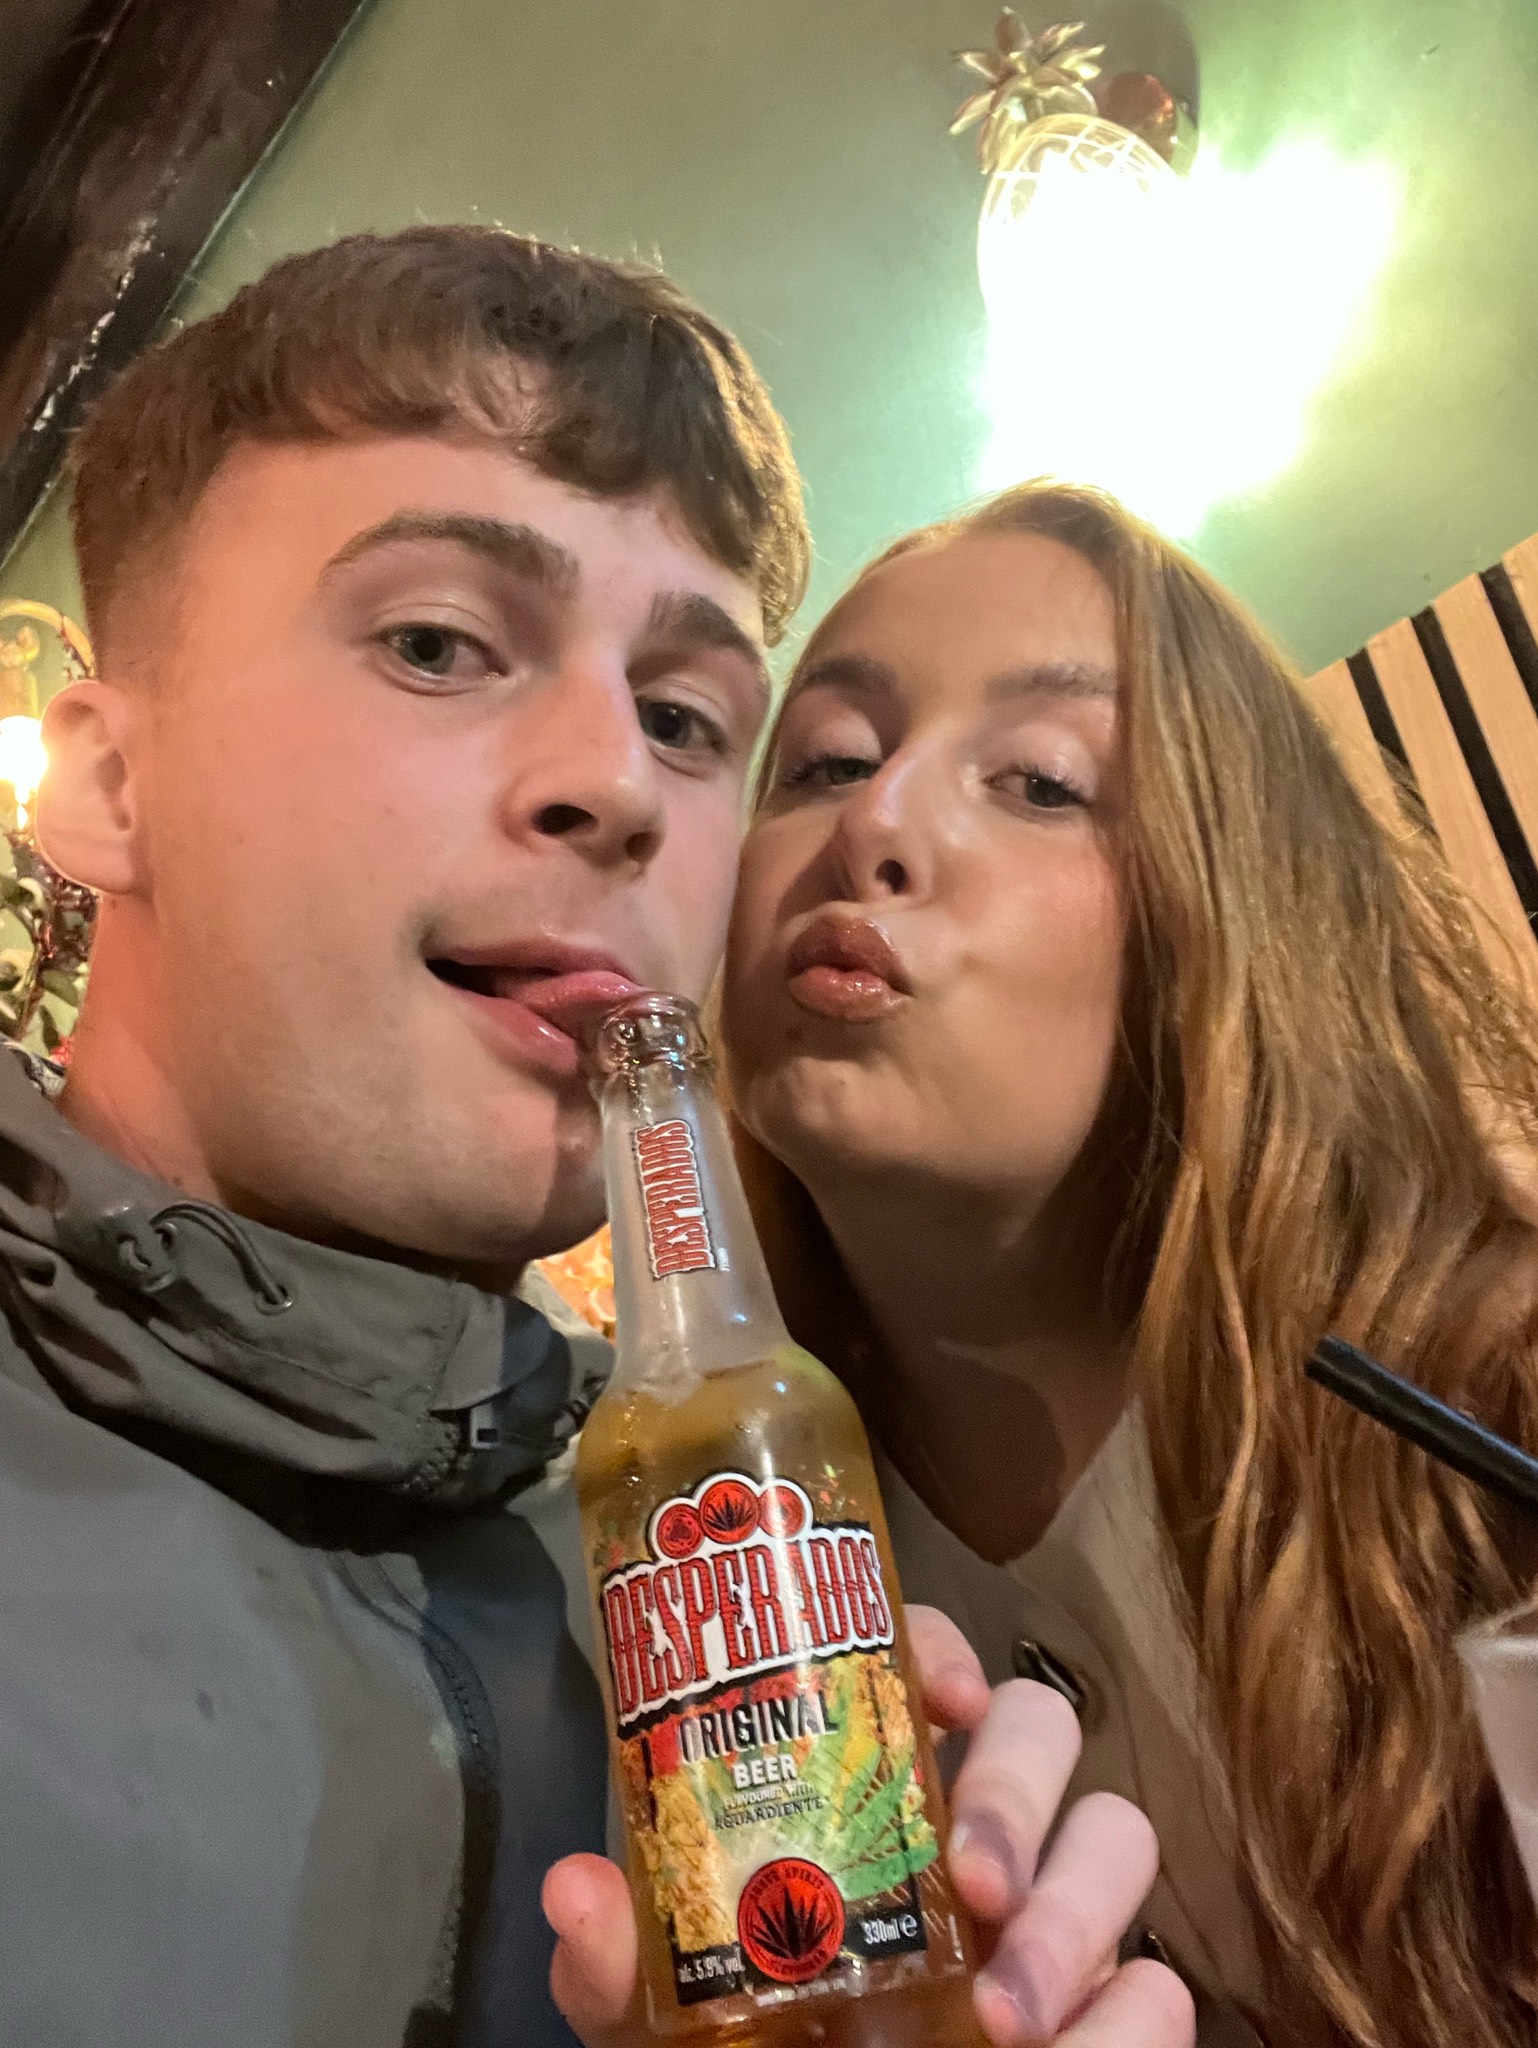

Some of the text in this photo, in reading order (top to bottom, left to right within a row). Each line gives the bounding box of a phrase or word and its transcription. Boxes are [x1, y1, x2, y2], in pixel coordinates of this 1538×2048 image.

[636, 1120, 713, 1277] DESPERADOS
[603, 1534, 893, 1717] DESPERADOS
[679, 1689, 839, 1764] ORIGINAL
[732, 1753, 798, 1790] BEER
[861, 1917, 900, 1945] 330ml
[695, 1955, 725, 1980] 5.9%
